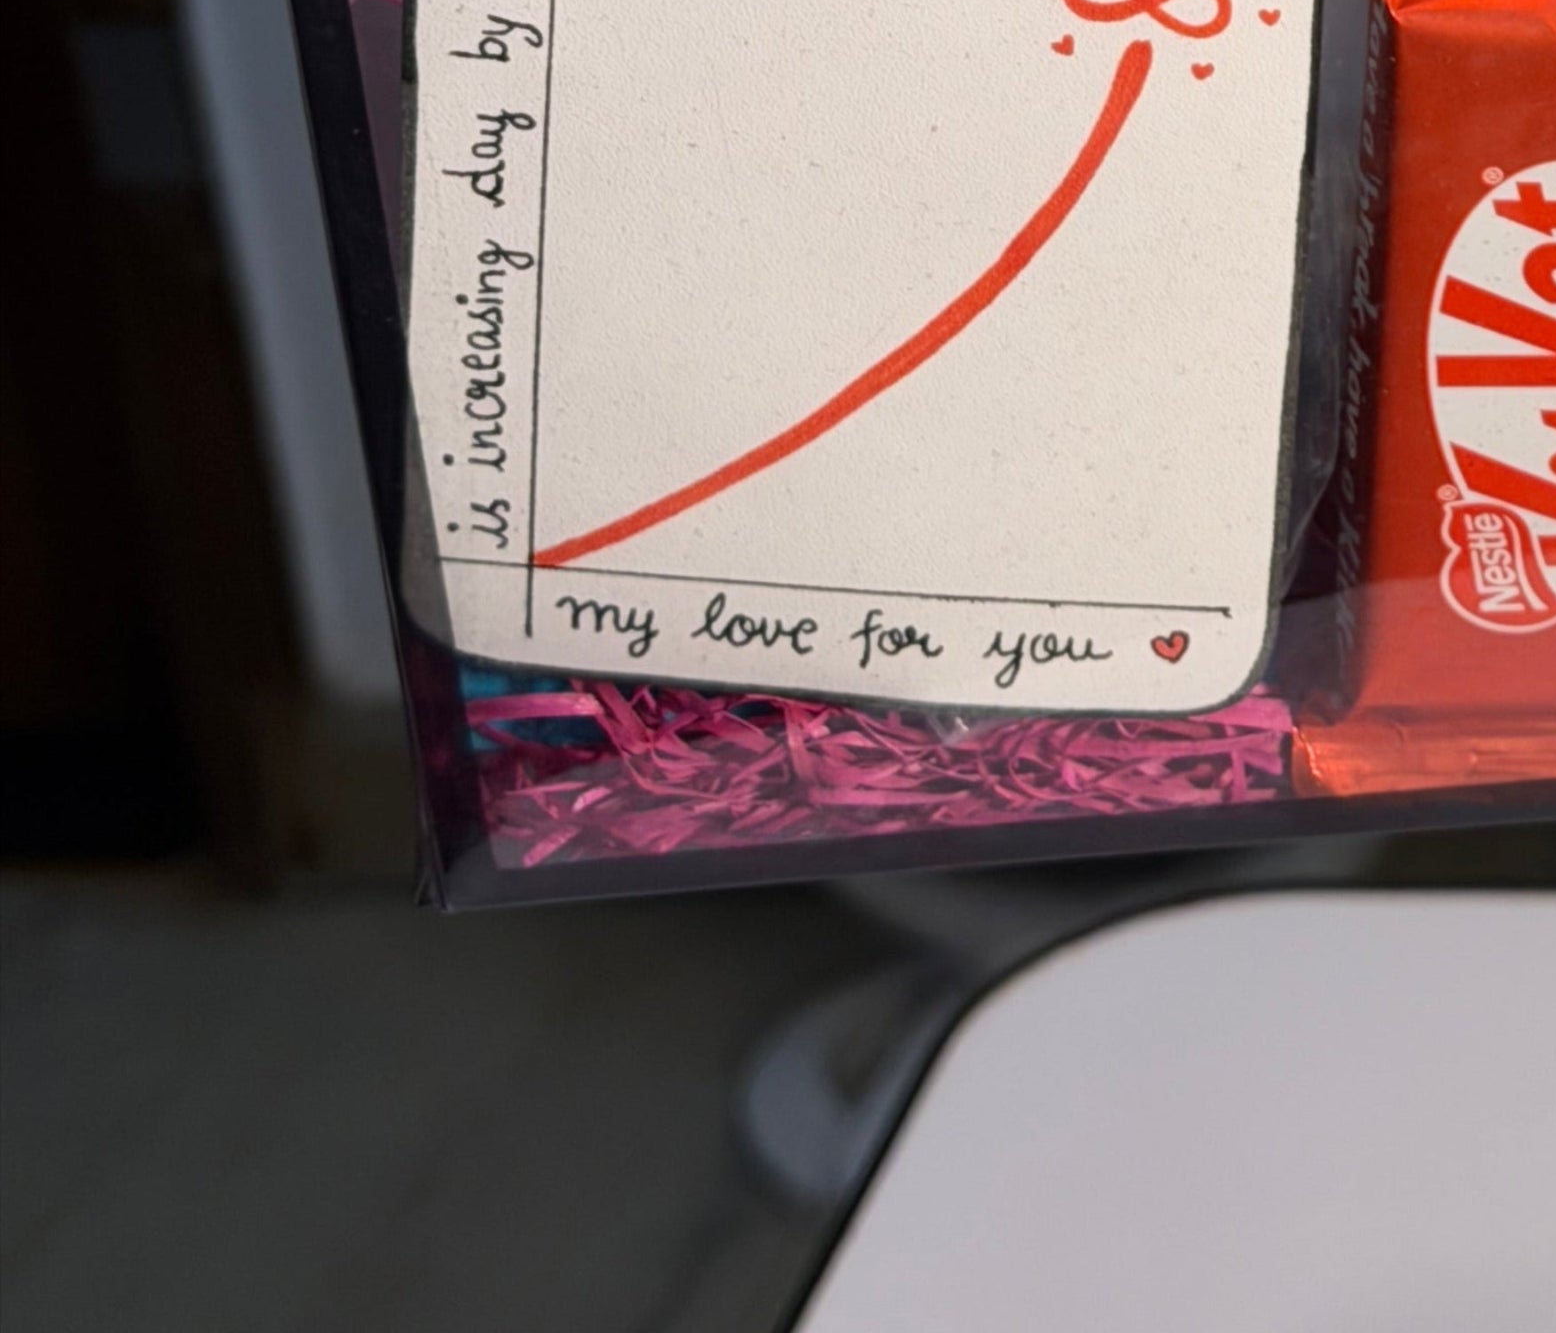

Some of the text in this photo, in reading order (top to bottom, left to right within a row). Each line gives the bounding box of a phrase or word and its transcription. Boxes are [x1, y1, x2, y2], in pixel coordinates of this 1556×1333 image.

[449, 14, 543, 63] by
[442, 110, 536, 208] day
[443, 240, 535, 472] increasing
[447, 499, 510, 549] is
[555, 592, 1112, 689] my love for you
